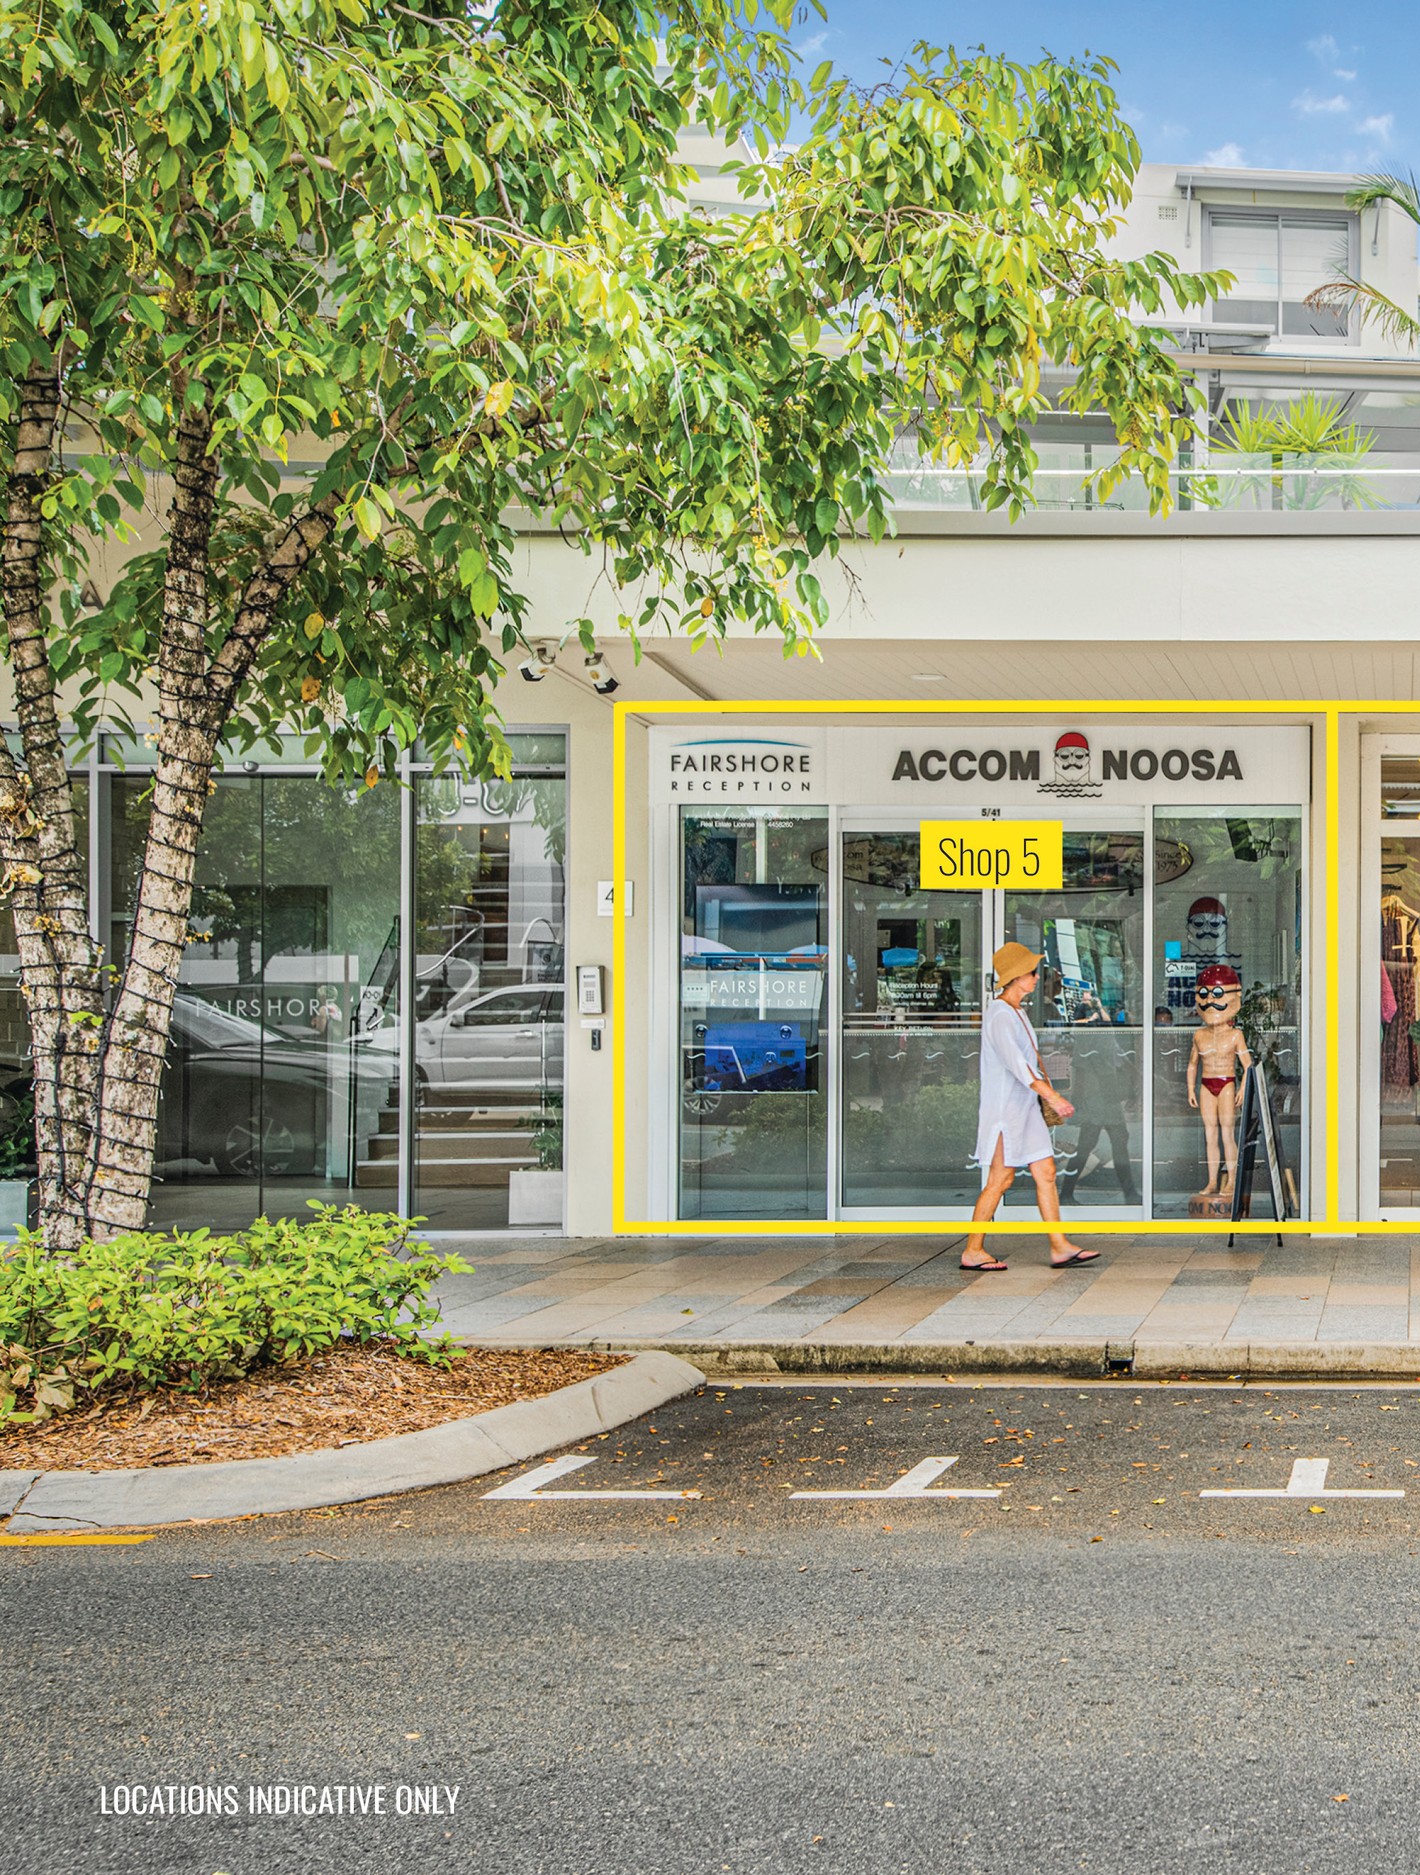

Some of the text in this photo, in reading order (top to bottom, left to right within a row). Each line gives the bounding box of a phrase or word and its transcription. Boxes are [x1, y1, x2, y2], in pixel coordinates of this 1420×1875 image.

[671, 755, 810, 773] FAIRSHORE
[892, 750, 1243, 781] ACCOM NOOSA
[671, 781, 811, 791] RECEPTION
[982, 808, 1000, 817] 5/41
